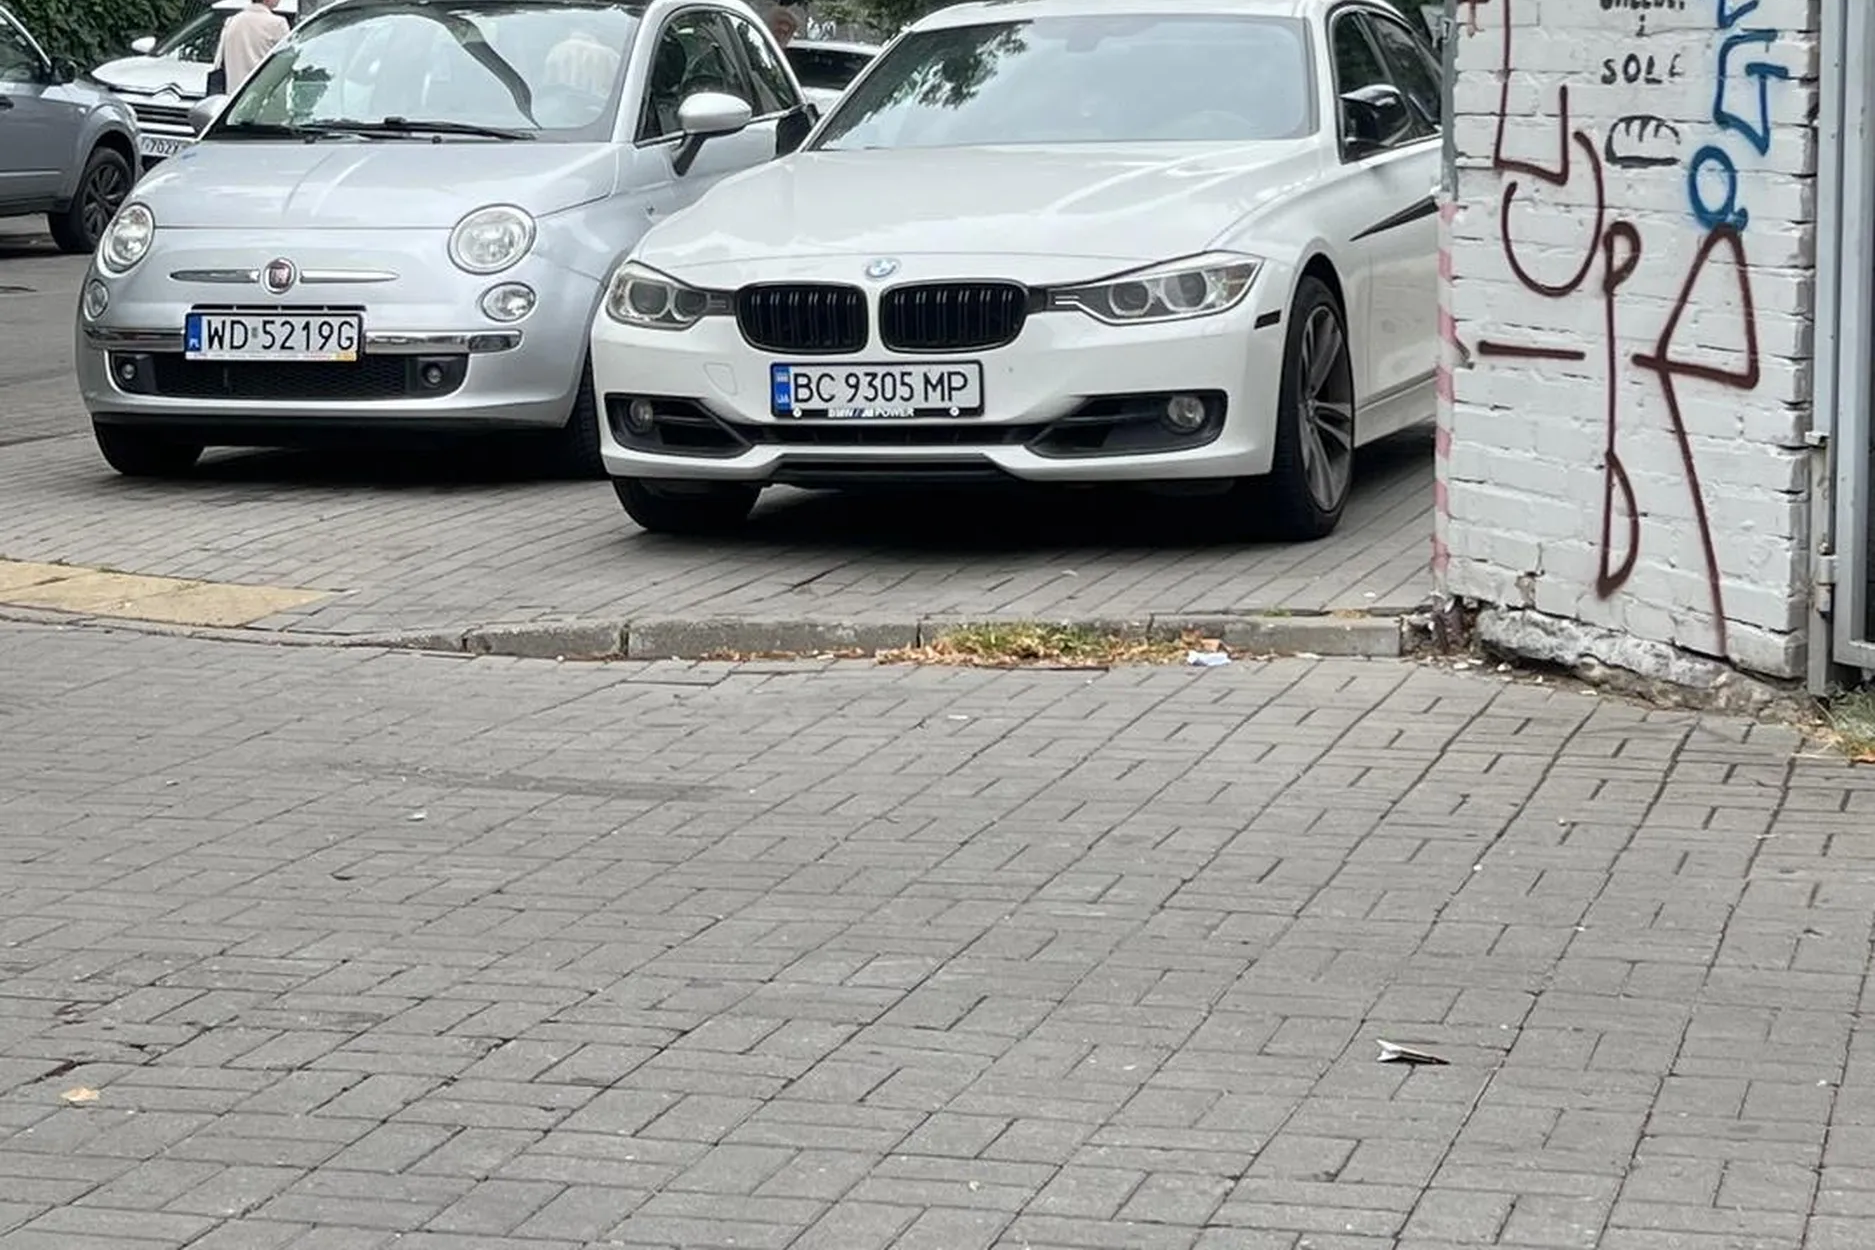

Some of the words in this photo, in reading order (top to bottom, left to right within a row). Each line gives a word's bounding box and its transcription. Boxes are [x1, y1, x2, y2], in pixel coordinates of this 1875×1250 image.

[207, 319, 249, 350] WD
[262, 320, 355, 350] 5219G
[793, 372, 836, 403] BC
[844, 371, 914, 403] 9305
[922, 370, 969, 403] MP
